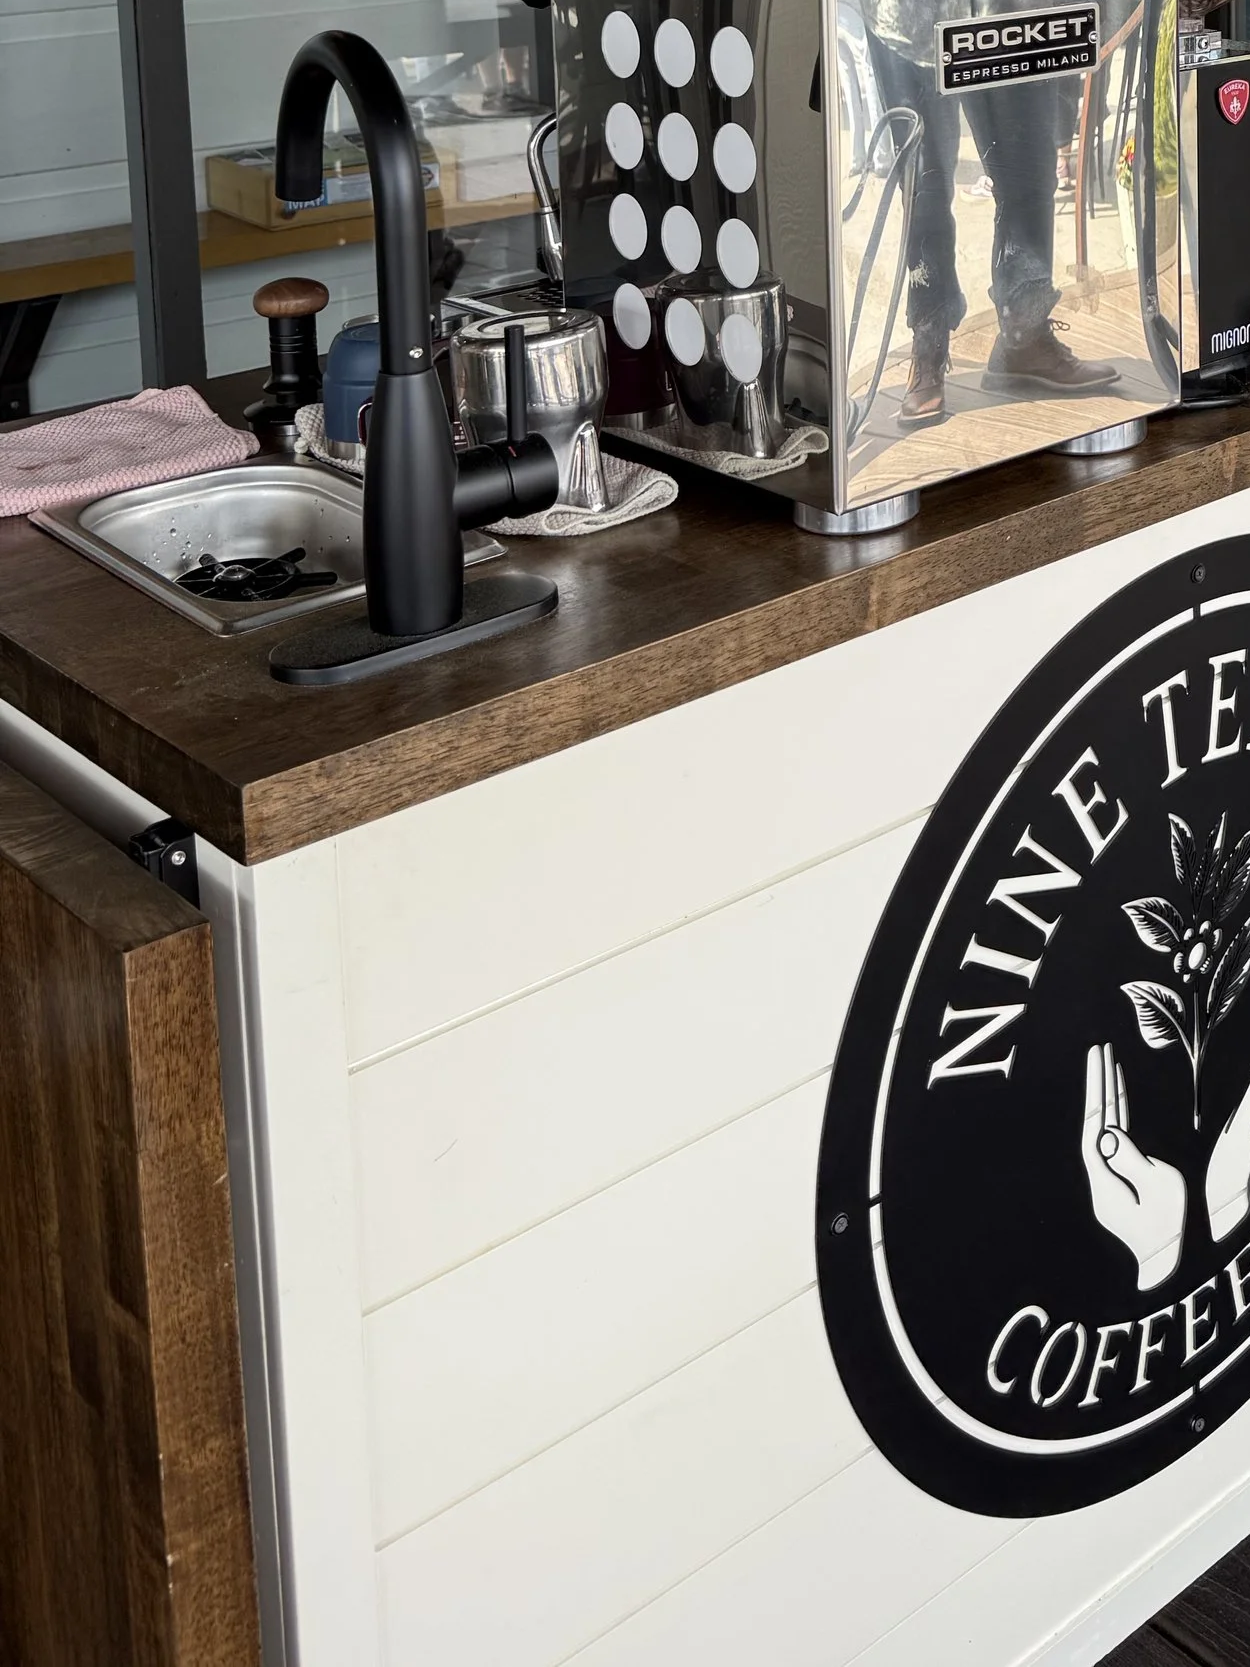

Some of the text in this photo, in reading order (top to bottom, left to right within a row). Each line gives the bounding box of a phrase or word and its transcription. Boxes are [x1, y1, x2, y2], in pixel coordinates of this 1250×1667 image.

[952, 16, 1088, 54] ROCKET
[953, 52, 1089, 82] ESPRESSO MILANO
[927, 745, 1131, 1091] NINE
